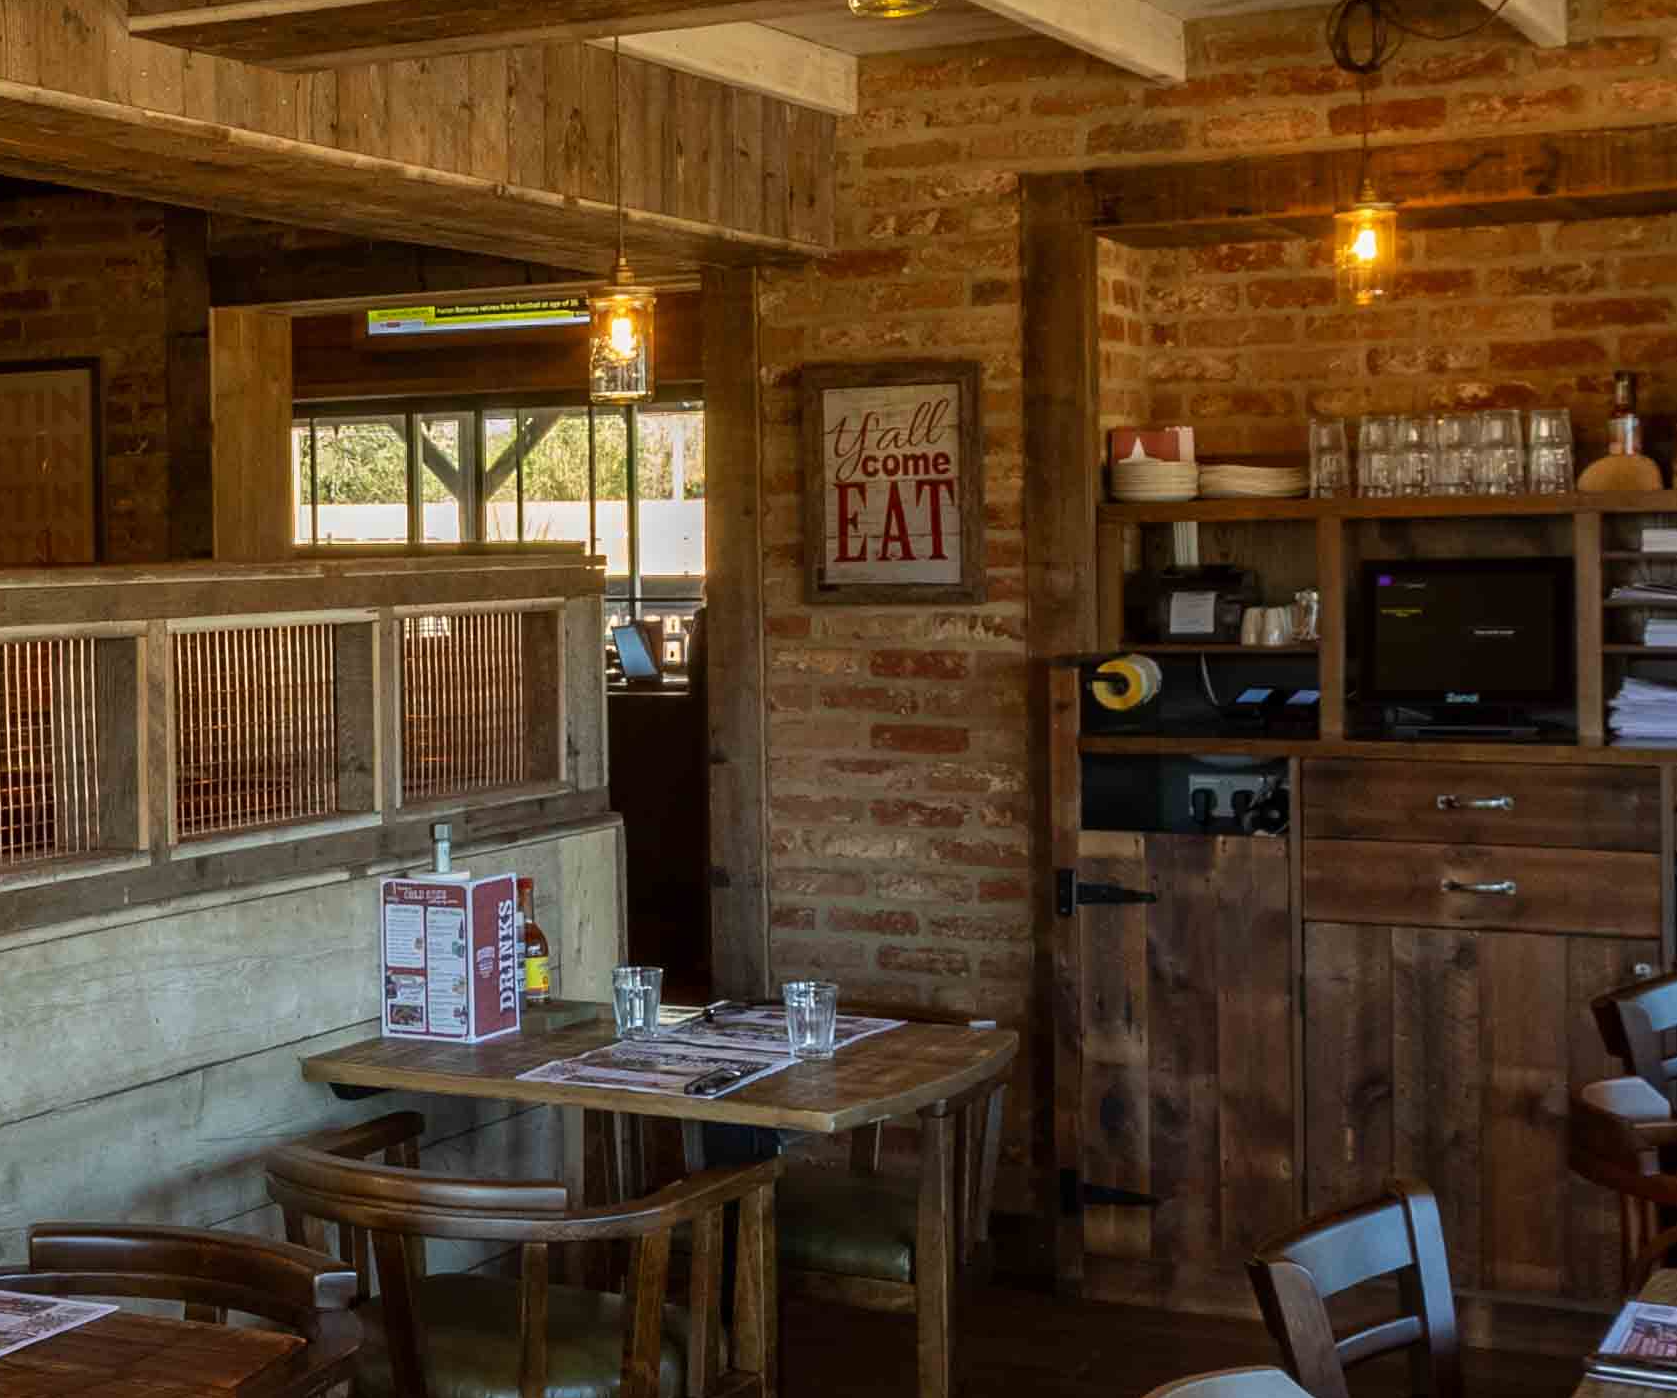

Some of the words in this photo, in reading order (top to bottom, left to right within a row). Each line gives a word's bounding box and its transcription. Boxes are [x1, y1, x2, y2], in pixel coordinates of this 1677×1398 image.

[827, 397, 949, 482] Y'all
[861, 452, 951, 477] come
[833, 477, 955, 562] EAT
[498, 899, 516, 1013] DRINKS
